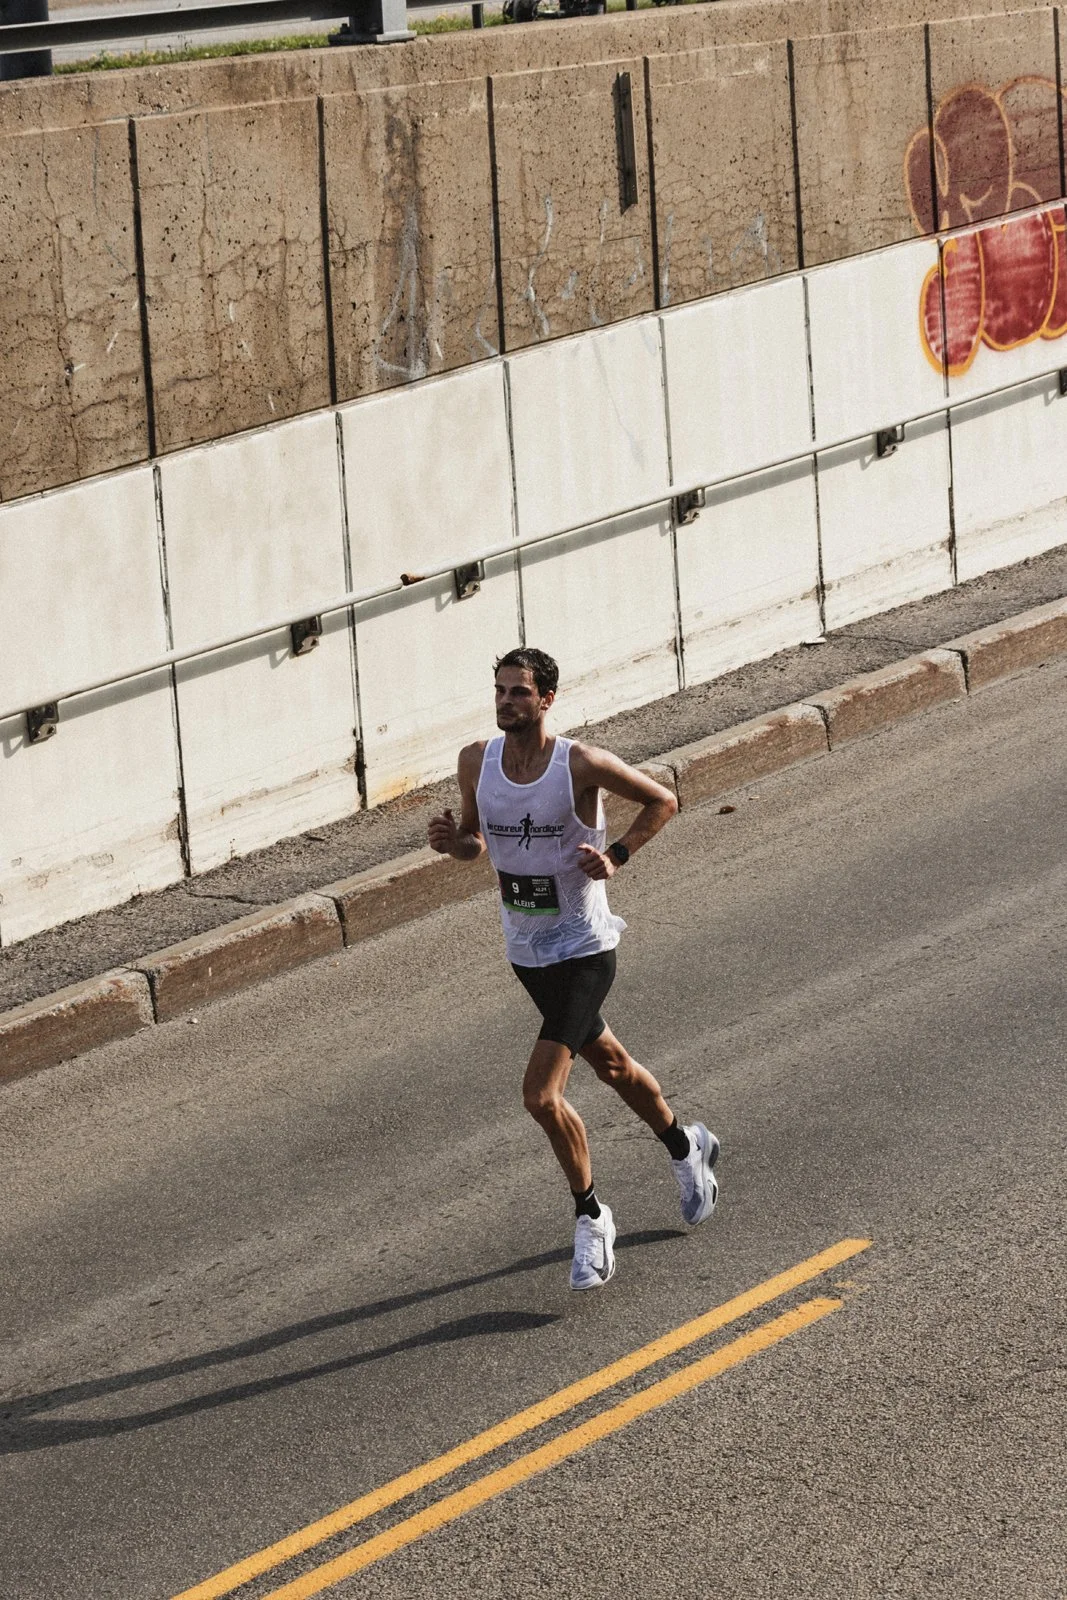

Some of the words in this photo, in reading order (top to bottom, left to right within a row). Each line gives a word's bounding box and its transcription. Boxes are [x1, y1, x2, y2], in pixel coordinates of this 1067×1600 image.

[493, 824, 523, 832] coureur
[530, 824, 565, 834] nordique
[511, 882, 520, 894] 9
[513, 899, 536, 908] ALEXIS
